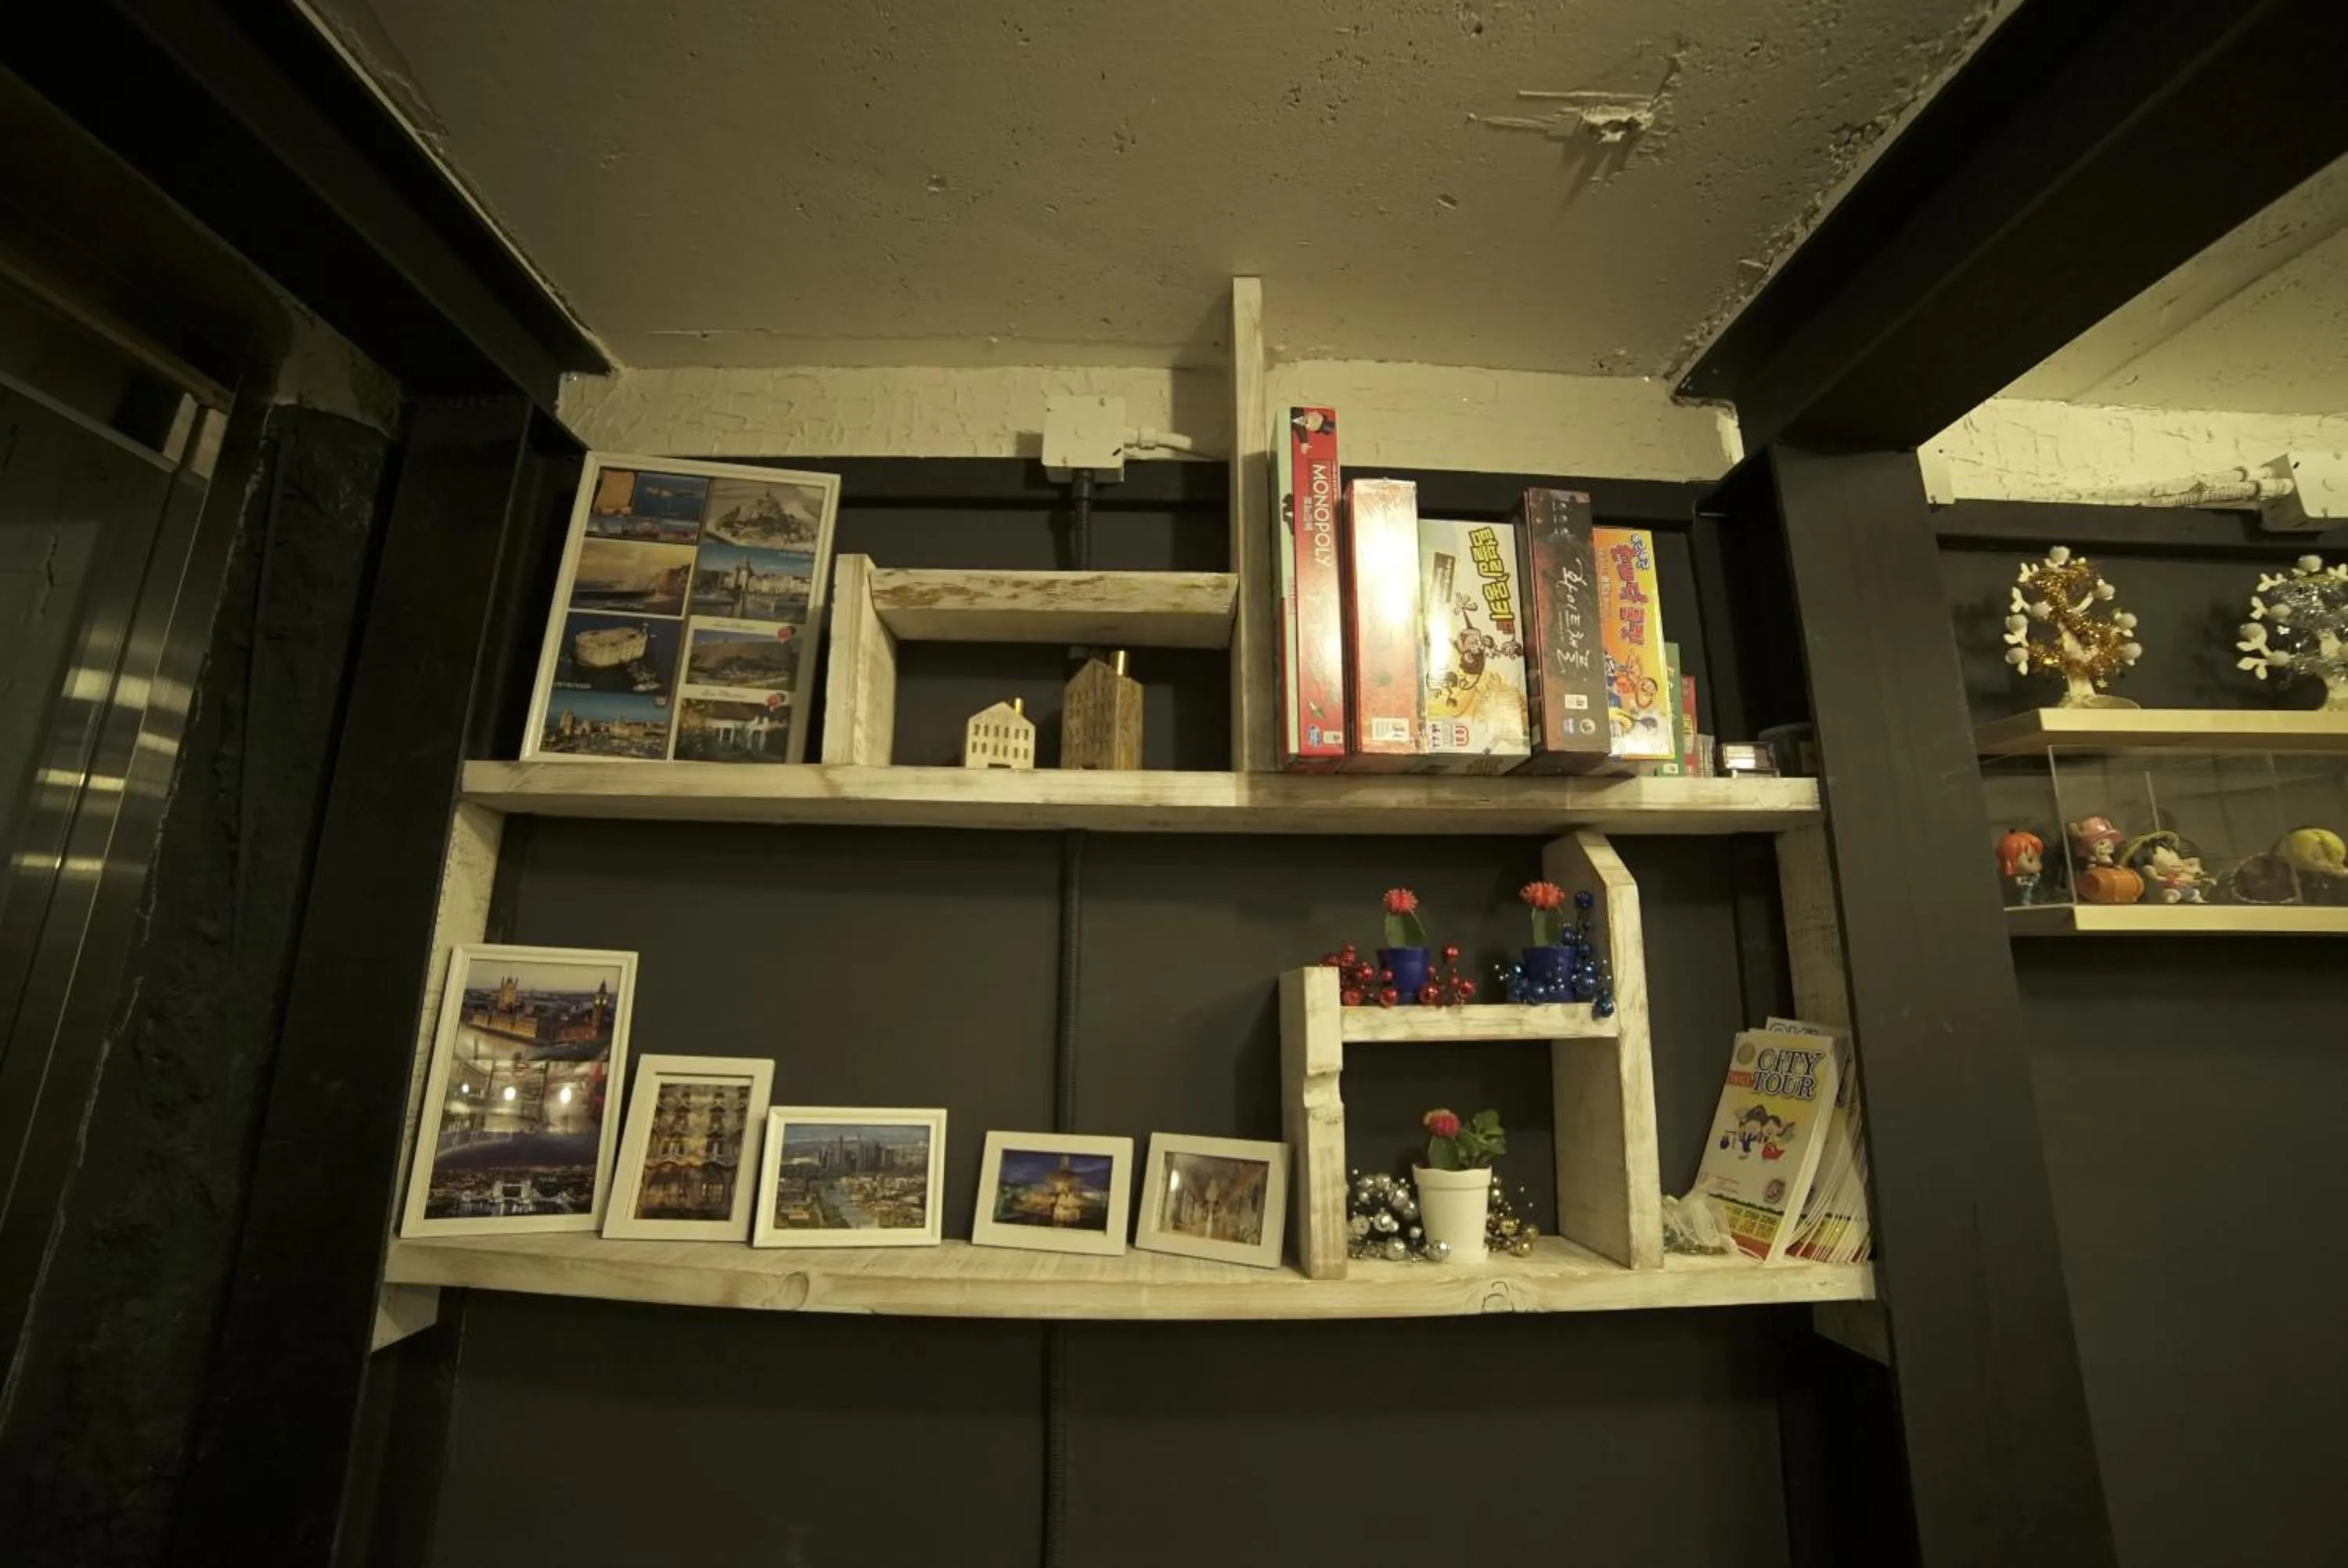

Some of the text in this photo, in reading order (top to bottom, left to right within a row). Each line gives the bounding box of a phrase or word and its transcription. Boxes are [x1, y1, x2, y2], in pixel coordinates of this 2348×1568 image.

[1312, 464, 1331, 566] MONOPOLY
[1468, 526, 1504, 577] 텀블링
[1482, 581, 1515, 620] 몽키
[1556, 557, 1590, 673] 화이트채플
[1756, 1048, 1823, 1075] CITY
[1754, 1071, 1815, 1098] TOUR
